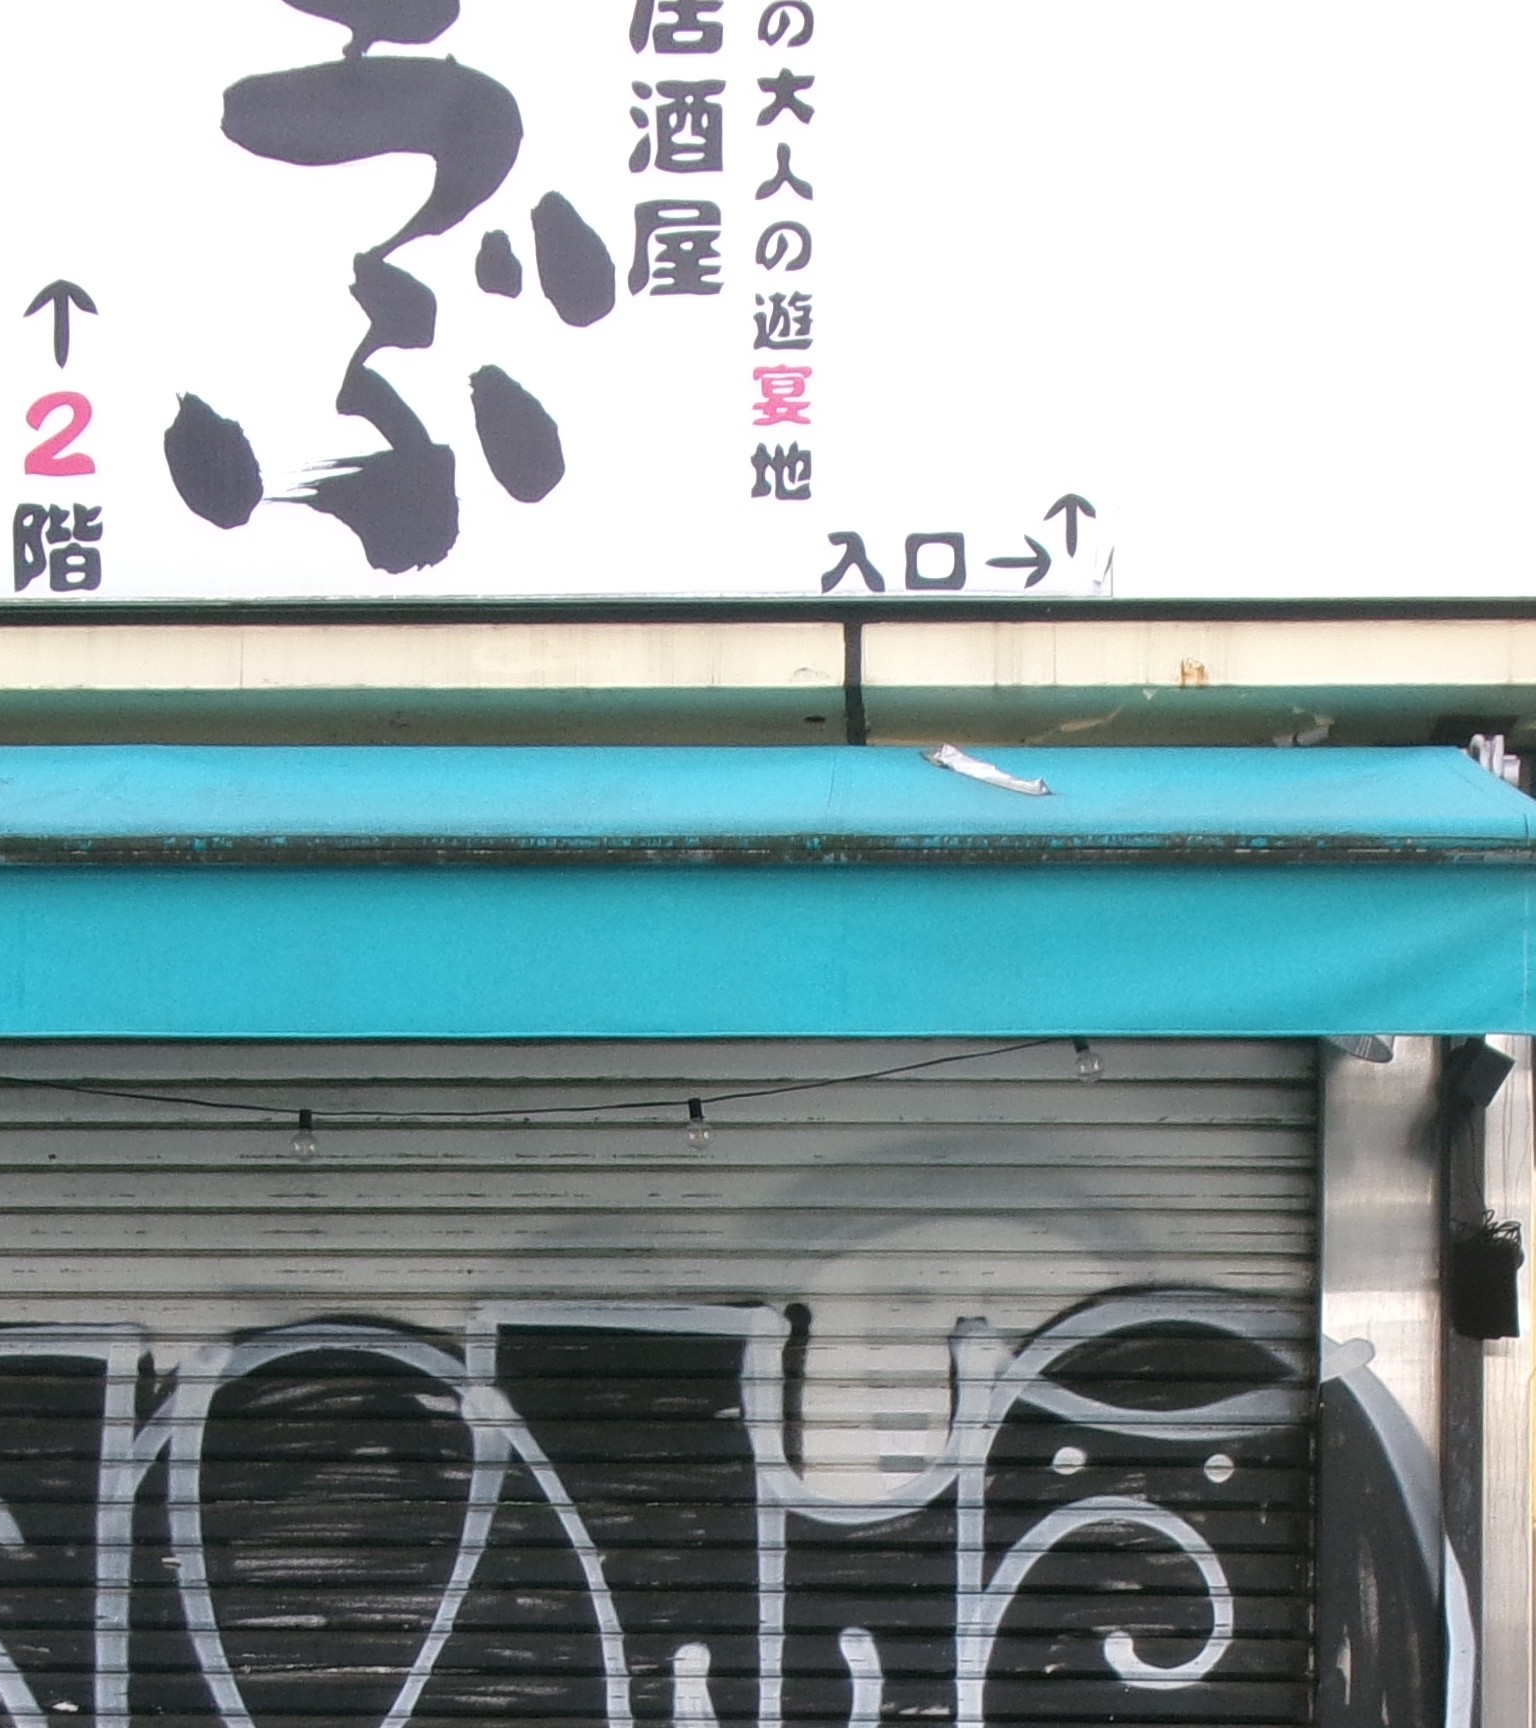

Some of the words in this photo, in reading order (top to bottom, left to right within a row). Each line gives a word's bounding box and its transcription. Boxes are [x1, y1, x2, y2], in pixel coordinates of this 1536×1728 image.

[628, 0, 726, 296] 居酒屋
[13, 391, 104, 592] 2階
[821, 532, 967, 592] 入口
